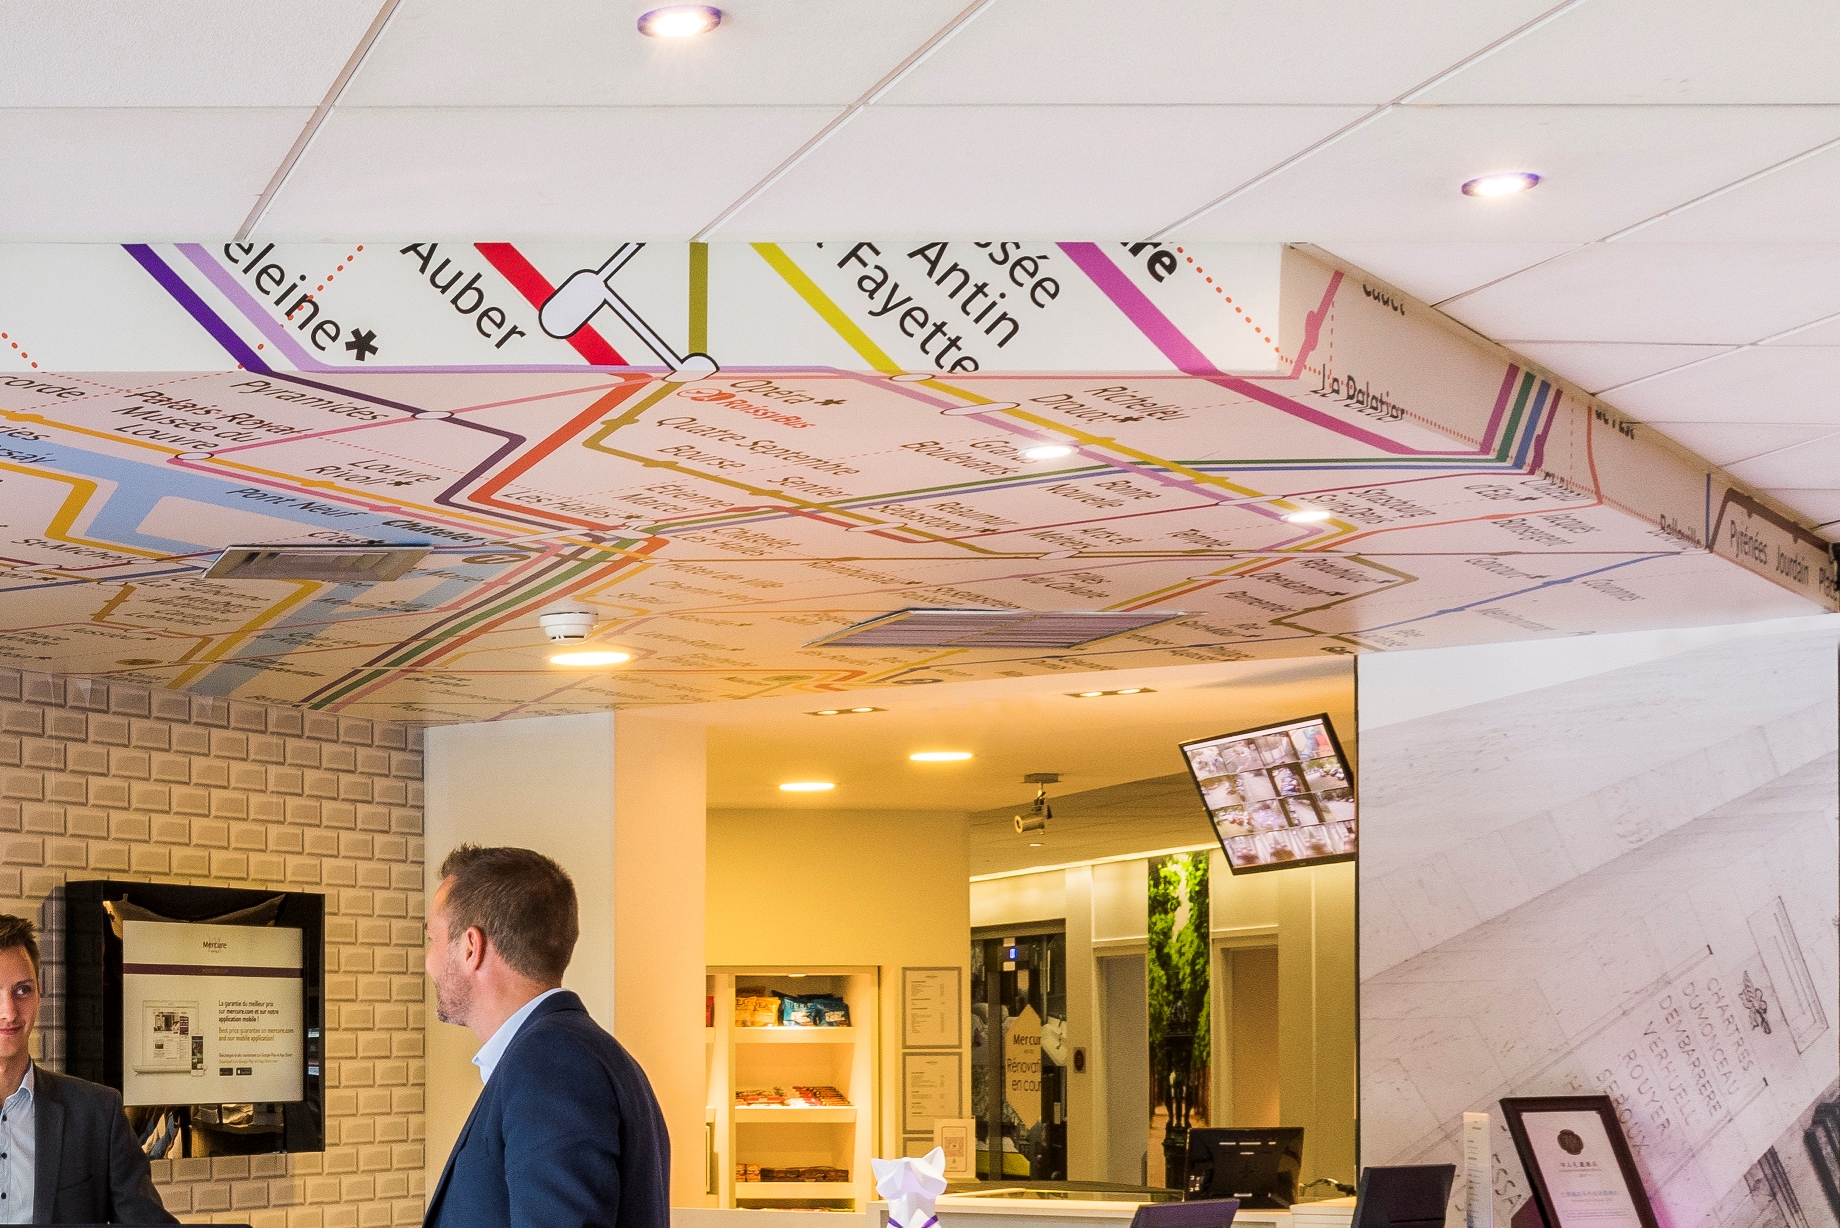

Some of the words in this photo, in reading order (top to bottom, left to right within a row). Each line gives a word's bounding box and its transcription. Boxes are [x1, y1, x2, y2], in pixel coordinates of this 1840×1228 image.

[400, 242, 526, 349] Auber
[837, 242, 980, 375] Fayette
[907, 242, 1019, 350] Antin
[229, 380, 389, 421] Pyramides
[111, 406, 218, 432] Musée
[213, 428, 262, 443] du
[113, 423, 220, 450] Louvre
[657, 445, 747, 470] Bourse
[202, 941, 228, 950] Mercure
[1708, 977, 1754, 1072] CHARTRES
[1012, 1080, 1022, 1092] en
